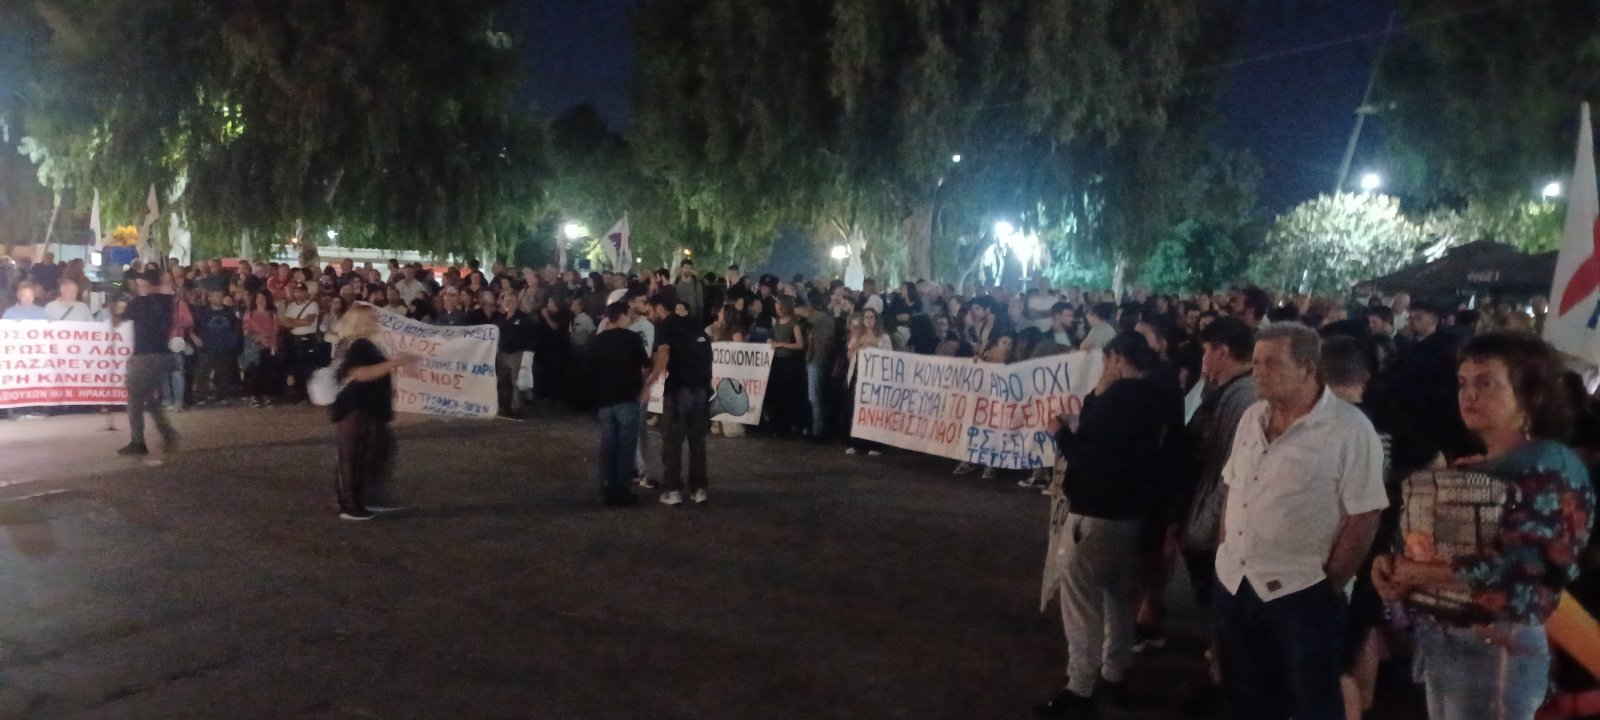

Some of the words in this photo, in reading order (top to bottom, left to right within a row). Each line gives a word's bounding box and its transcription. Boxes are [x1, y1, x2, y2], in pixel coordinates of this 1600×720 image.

[0, 358, 128, 370] ΠΑΖΑΡΕΥΟΥ
[66, 344, 81, 355] Ο
[88, 345, 132, 356] ΛΑΟ
[864, 352, 904, 383] ΥΓΕΙΑ
[913, 360, 984, 393] ΚΟΙΝΩΝΙΚΟ
[1032, 361, 1070, 395] ΟΧΙ
[860, 382, 947, 418] ΕΜΠΟΡΕΥΜΑ!
[951, 393, 967, 420] ΤΟ
[858, 407, 905, 432] ΑΝΗΚΕΙ
[904, 414, 929, 439] ΣΤΟ
